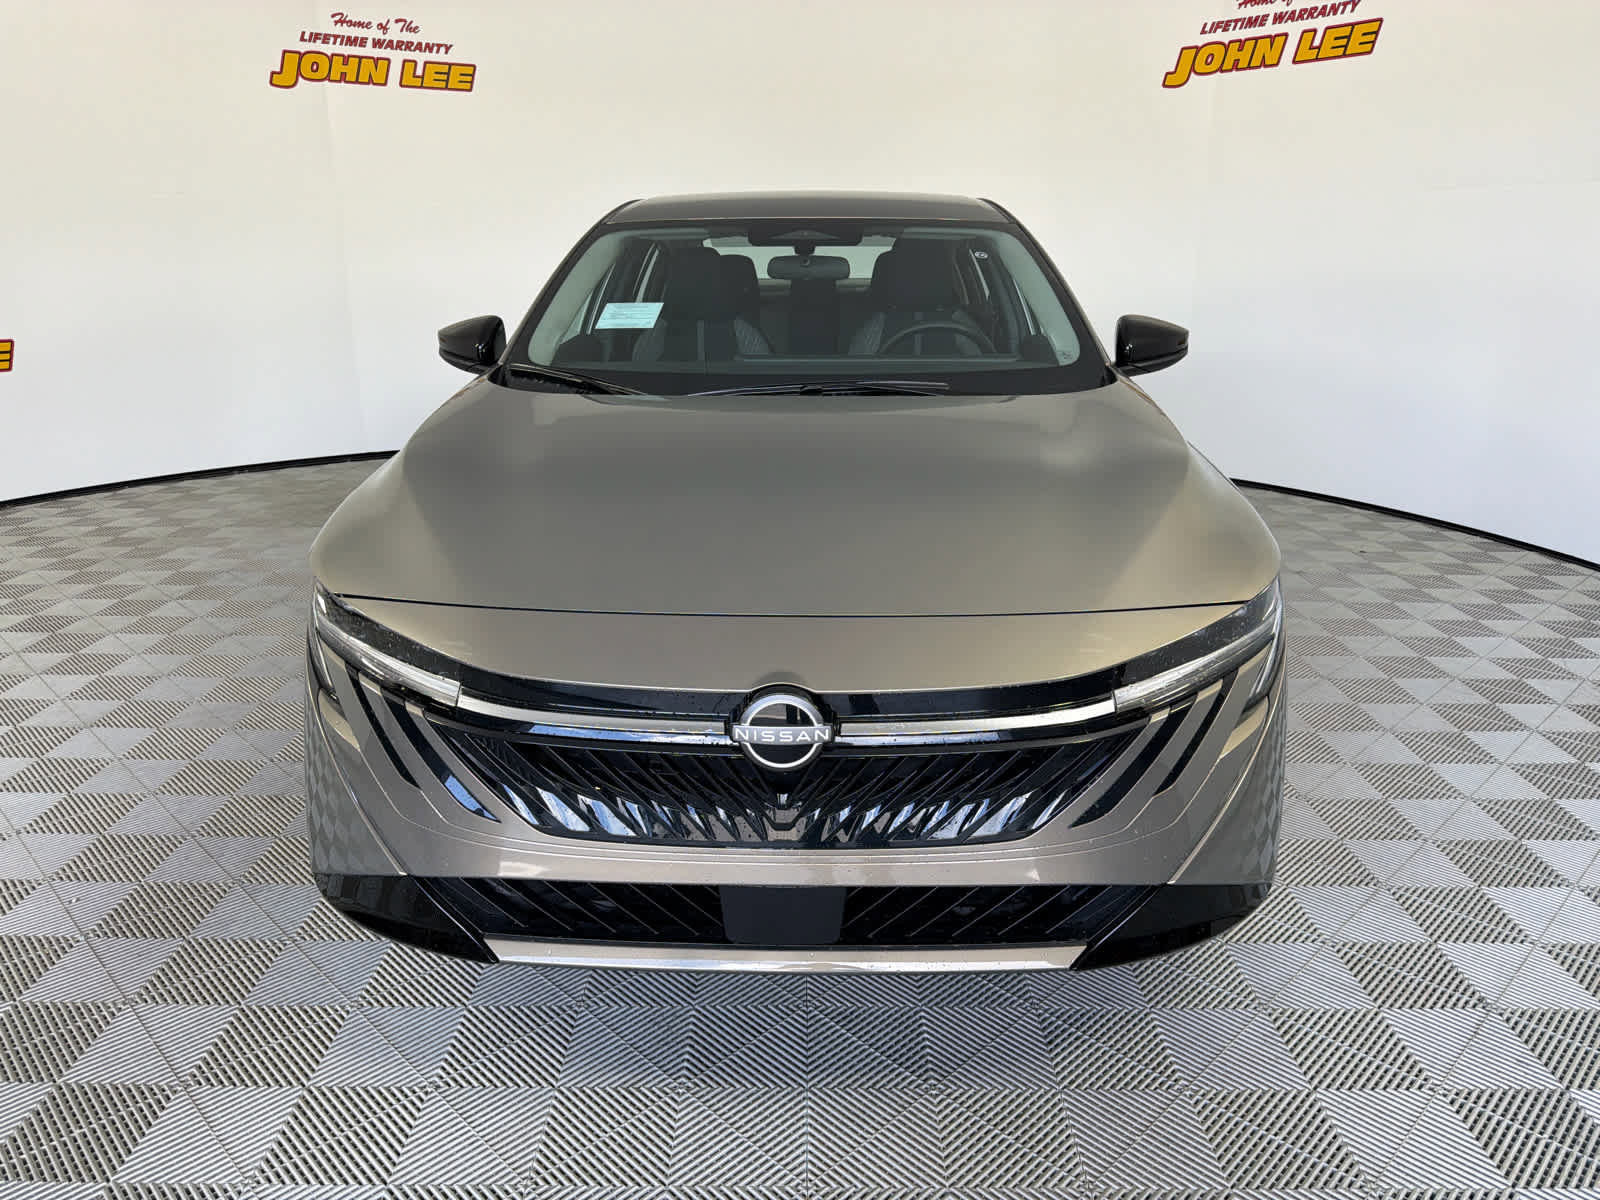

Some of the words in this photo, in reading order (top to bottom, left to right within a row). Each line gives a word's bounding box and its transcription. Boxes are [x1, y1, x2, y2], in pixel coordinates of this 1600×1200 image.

[331, 12, 373, 30] Home
[376, 19, 390, 35] of
[394, 18, 421, 34] The
[1200, 13, 1269, 35] LIFETIME
[1272, 0, 1361, 25] WARRANTY
[300, 31, 368, 48] LIFETIME
[371, 37, 453, 54] WARRANTY
[1162, 32, 1289, 88] JOHN
[1292, 18, 1383, 64] LEE
[270, 50, 391, 88] JOHN
[399, 59, 476, 92] LEE
[735, 728, 829, 742] NISSAN
